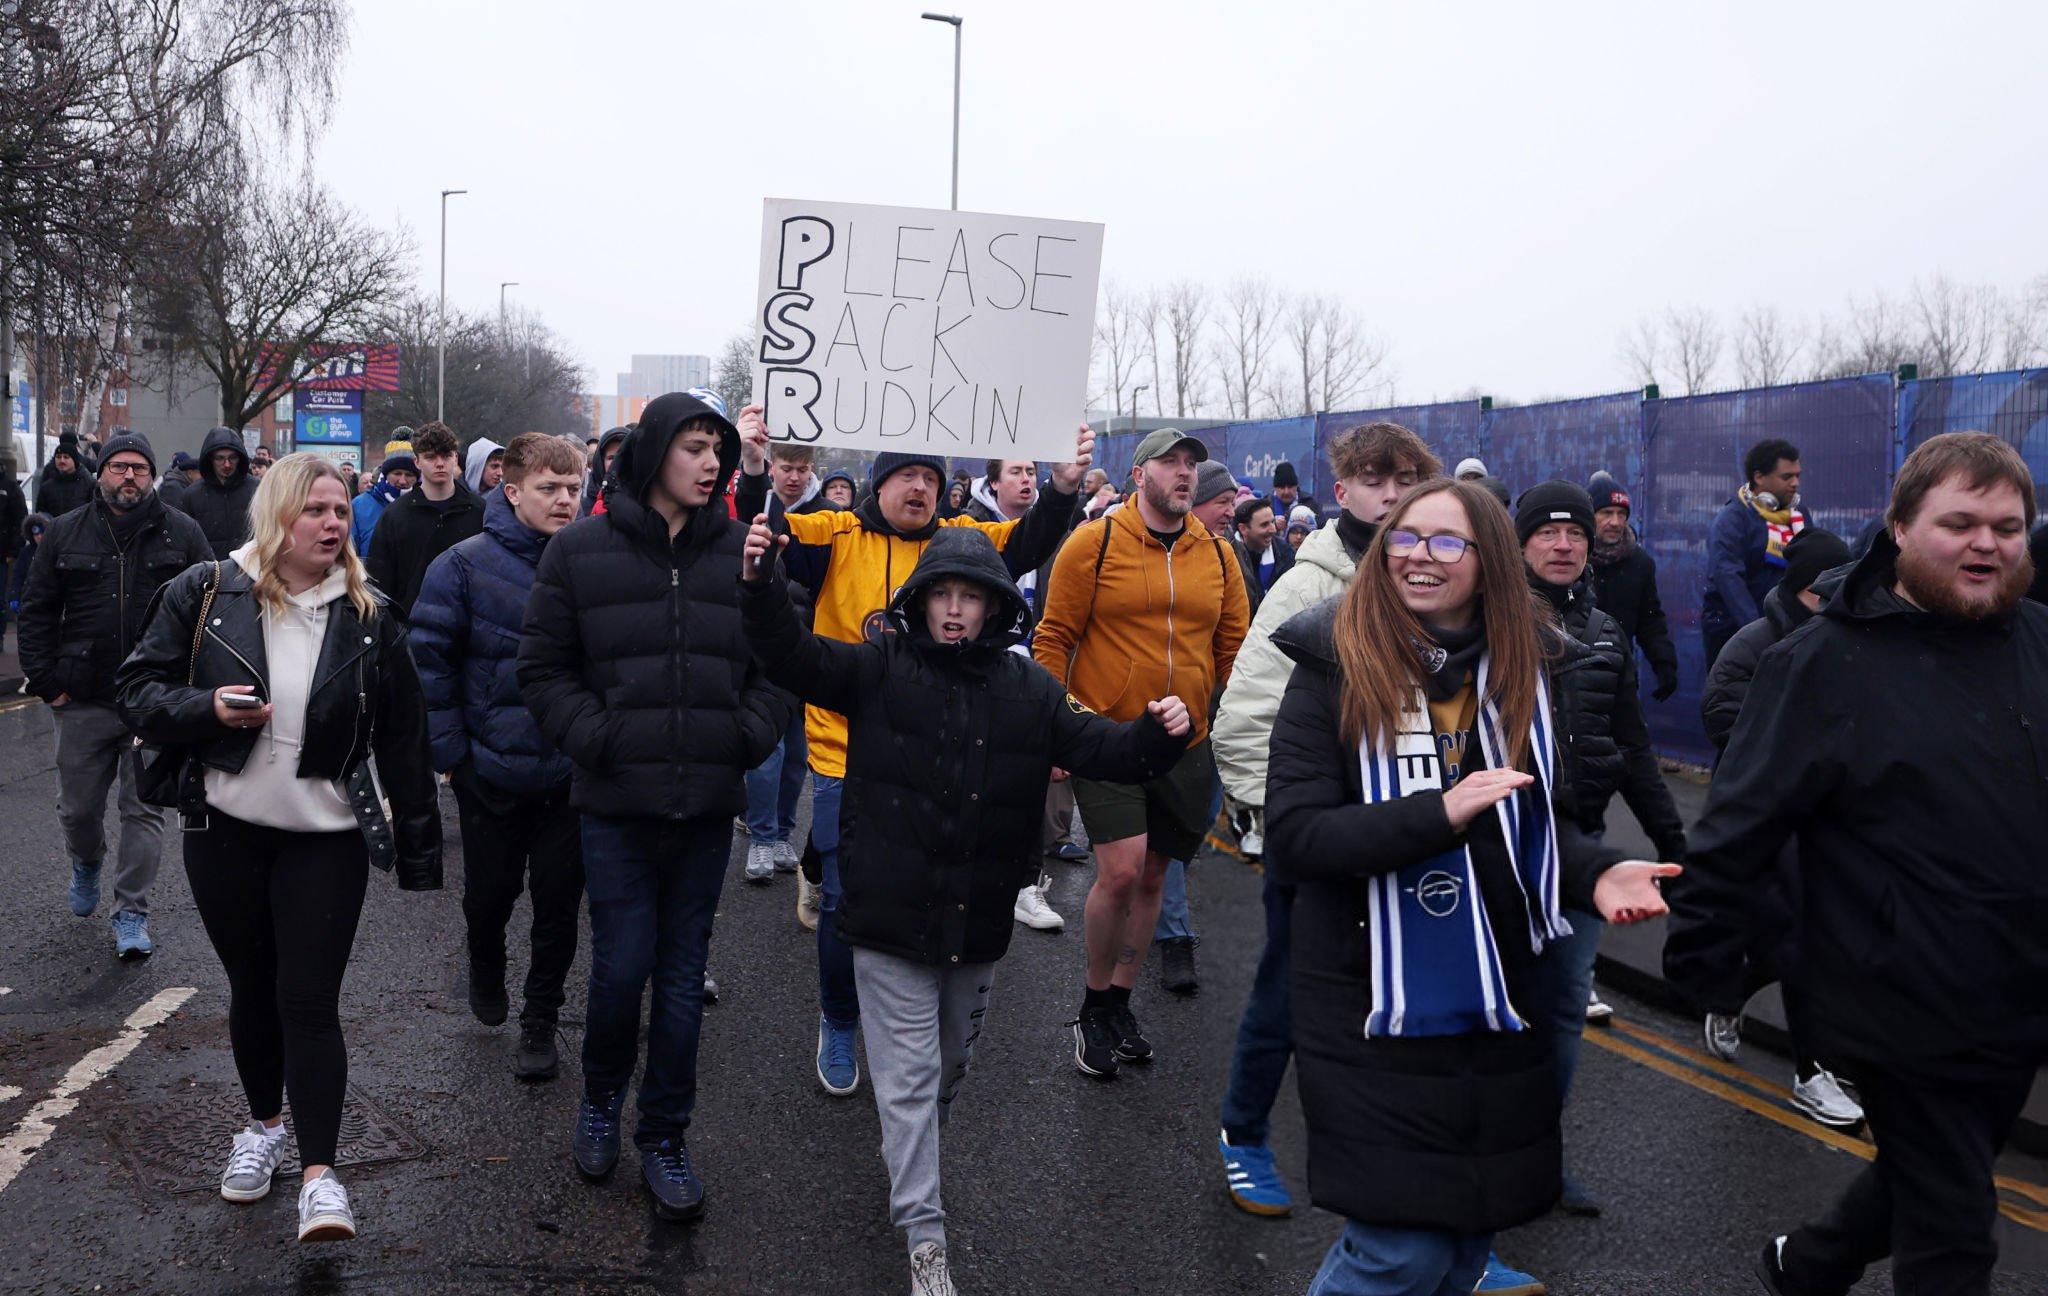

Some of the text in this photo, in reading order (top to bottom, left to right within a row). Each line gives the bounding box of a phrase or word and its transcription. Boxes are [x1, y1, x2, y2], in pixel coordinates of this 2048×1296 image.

[777, 215, 1077, 316] PLEASE
[760, 291, 973, 385] SACK
[330, 416, 343, 424] the
[764, 367, 1023, 444] RUDKIN
[1245, 454, 1262, 478] Car
